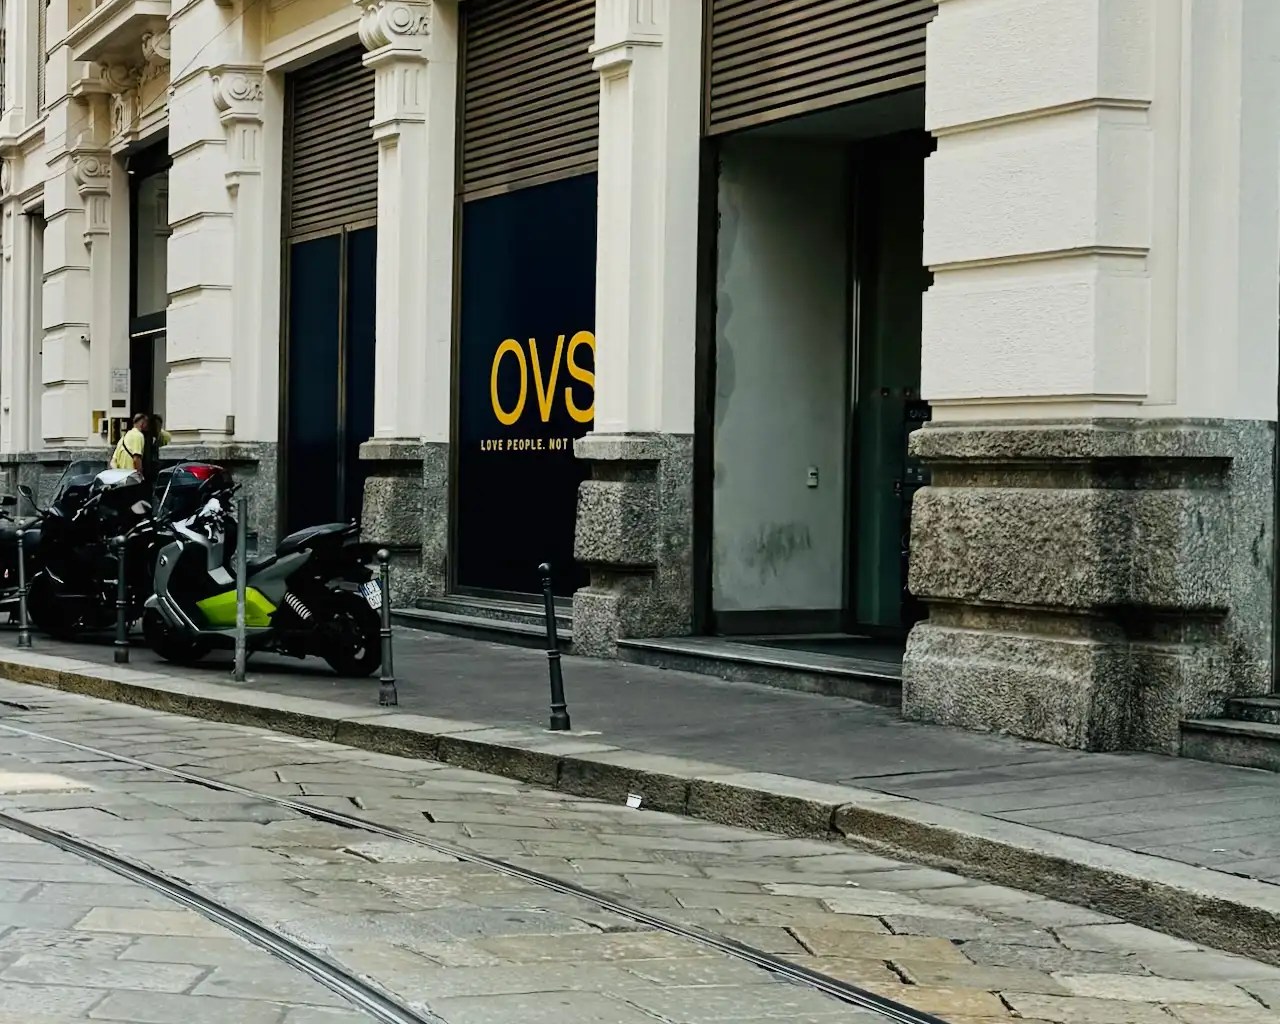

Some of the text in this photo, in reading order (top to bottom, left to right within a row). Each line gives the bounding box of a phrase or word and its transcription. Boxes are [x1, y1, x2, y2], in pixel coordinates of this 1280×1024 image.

[490, 330, 596, 426] OVS
[480, 439, 503, 451] LOVE
[507, 438, 546, 451] PEOPLE.
[549, 437, 568, 450] NOT
